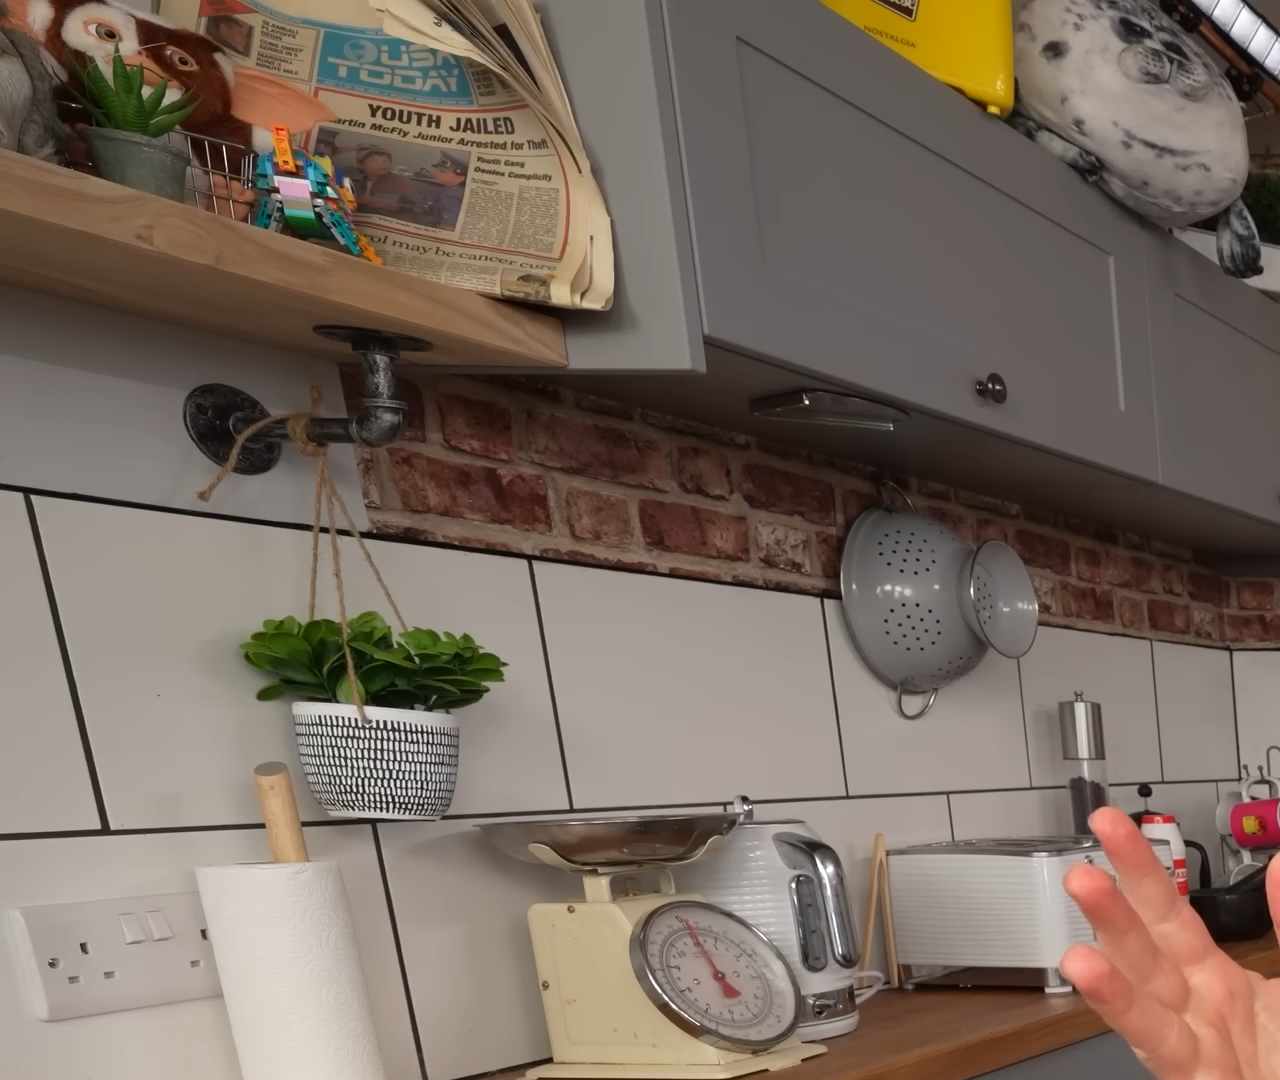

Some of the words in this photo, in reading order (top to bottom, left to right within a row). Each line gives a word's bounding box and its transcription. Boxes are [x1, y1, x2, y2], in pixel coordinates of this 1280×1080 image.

[863, 24, 917, 48] NOSTALGIA
[327, 56, 459, 93] TODAY
[328, 116, 366, 129] artin
[370, 122, 409, 138] McFly
[413, 131, 454, 145] Junior
[456, 138, 507, 151] Arrested
[510, 140, 524, 151] for
[527, 139, 549, 151] Theft
[367, 103, 441, 129] YOUTH
[449, 116, 516, 135] JAILED
[474, 166, 506, 178] Denies
[508, 172, 552, 182] Complicity
[476, 155, 502, 166] Youth
[503, 159, 526, 169] Gang
[392, 238, 432, 256] may
[435, 245, 456, 258] be
[459, 253, 518, 266] cancer
[520, 260, 557, 271] cure
